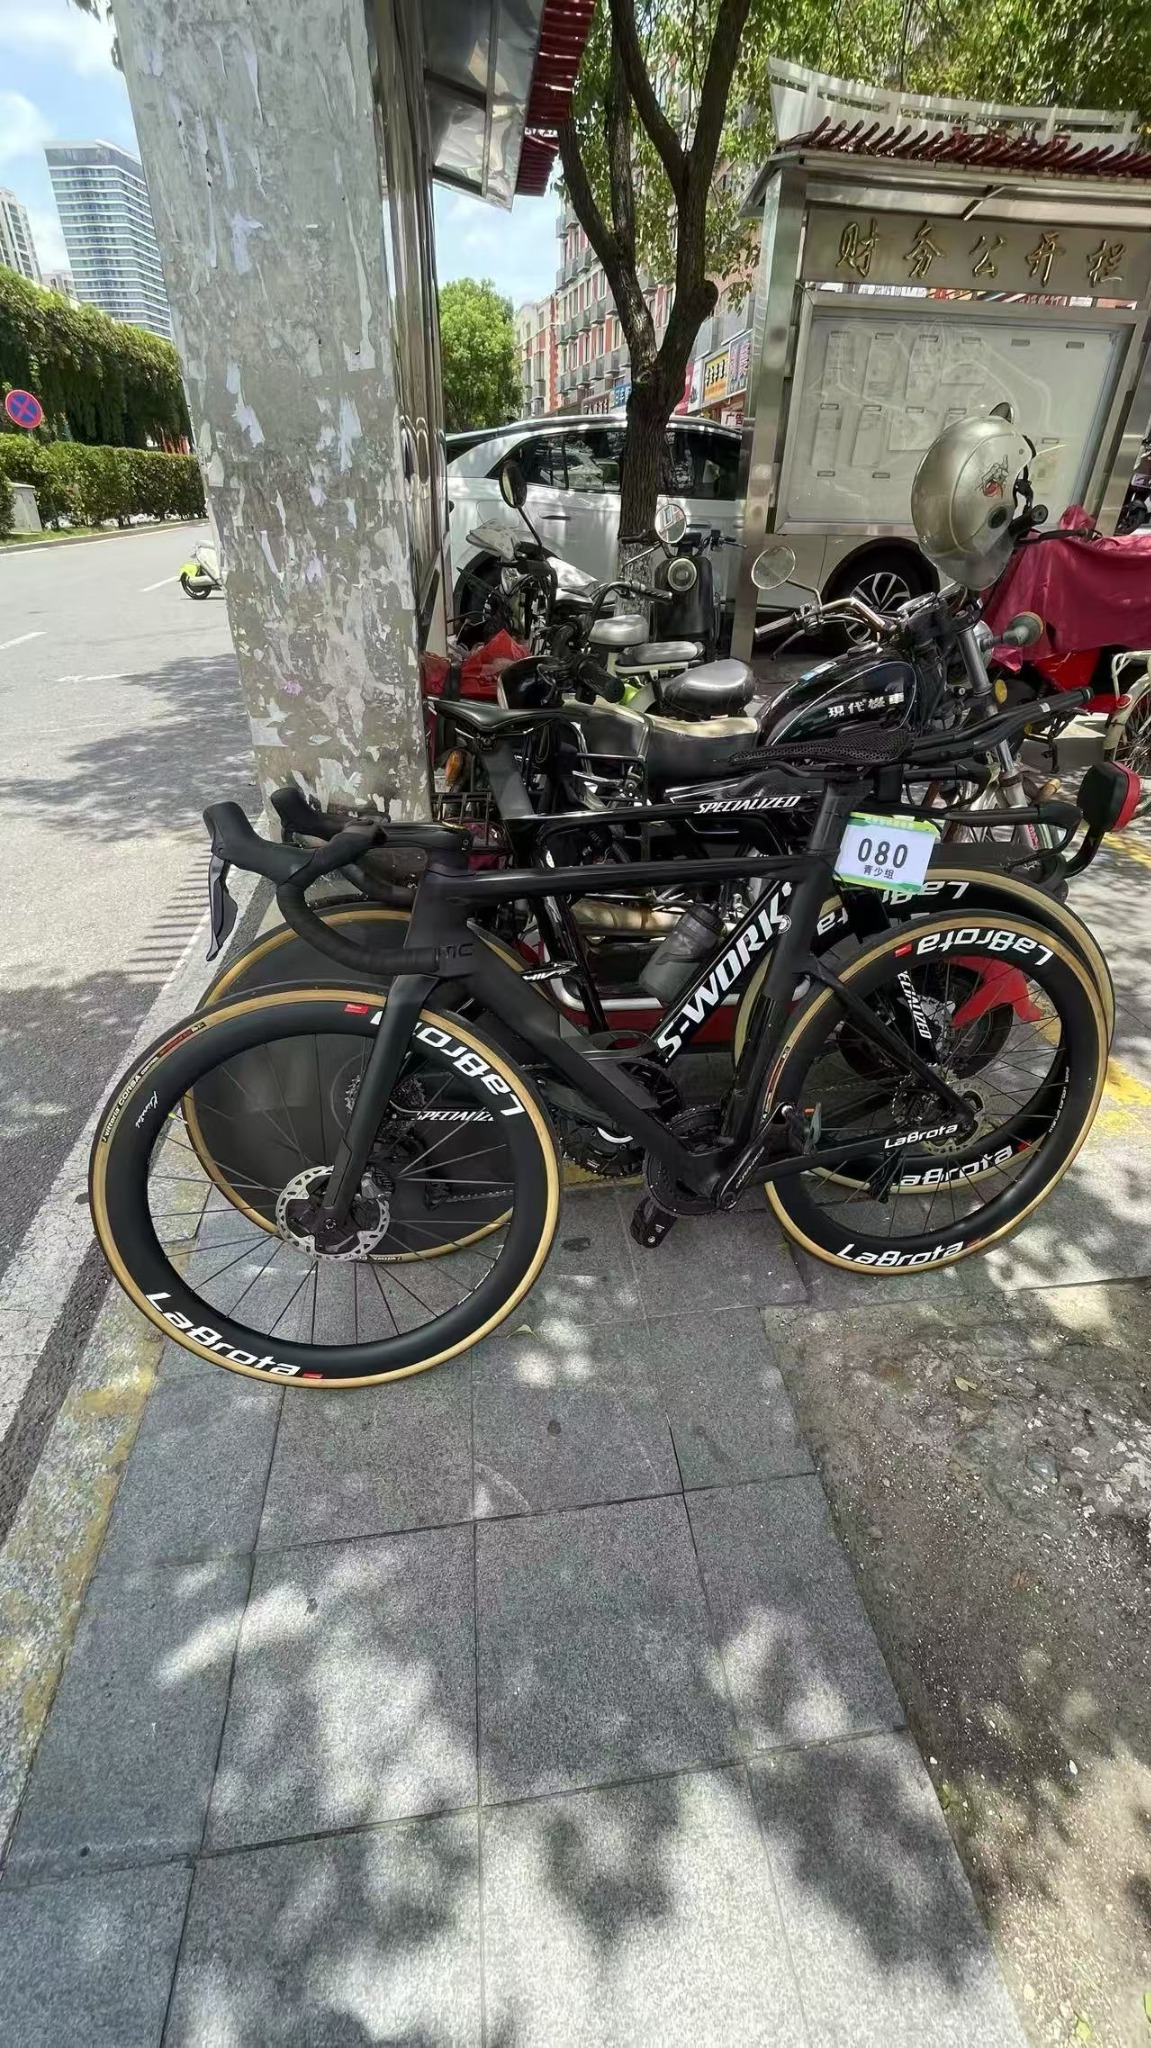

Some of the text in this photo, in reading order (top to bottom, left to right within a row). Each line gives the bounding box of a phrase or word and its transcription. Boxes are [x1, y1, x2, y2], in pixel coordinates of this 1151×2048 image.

[837, 217, 1126, 289] 财务公开栏
[694, 796, 801, 814] SPECIALIZED
[858, 838, 908, 869] 080
[863, 864, 895, 880] 青少组
[917, 929, 1054, 966] LaBrota
[657, 882, 792, 1059] S-WORK
[897, 971, 932, 1039] ECIALIZED
[884, 1124, 958, 1149] LaBrota
[892, 1145, 1013, 1186] aBrota
[836, 1241, 964, 1267] LaBrota
[146, 1292, 301, 1377] LaBrota
